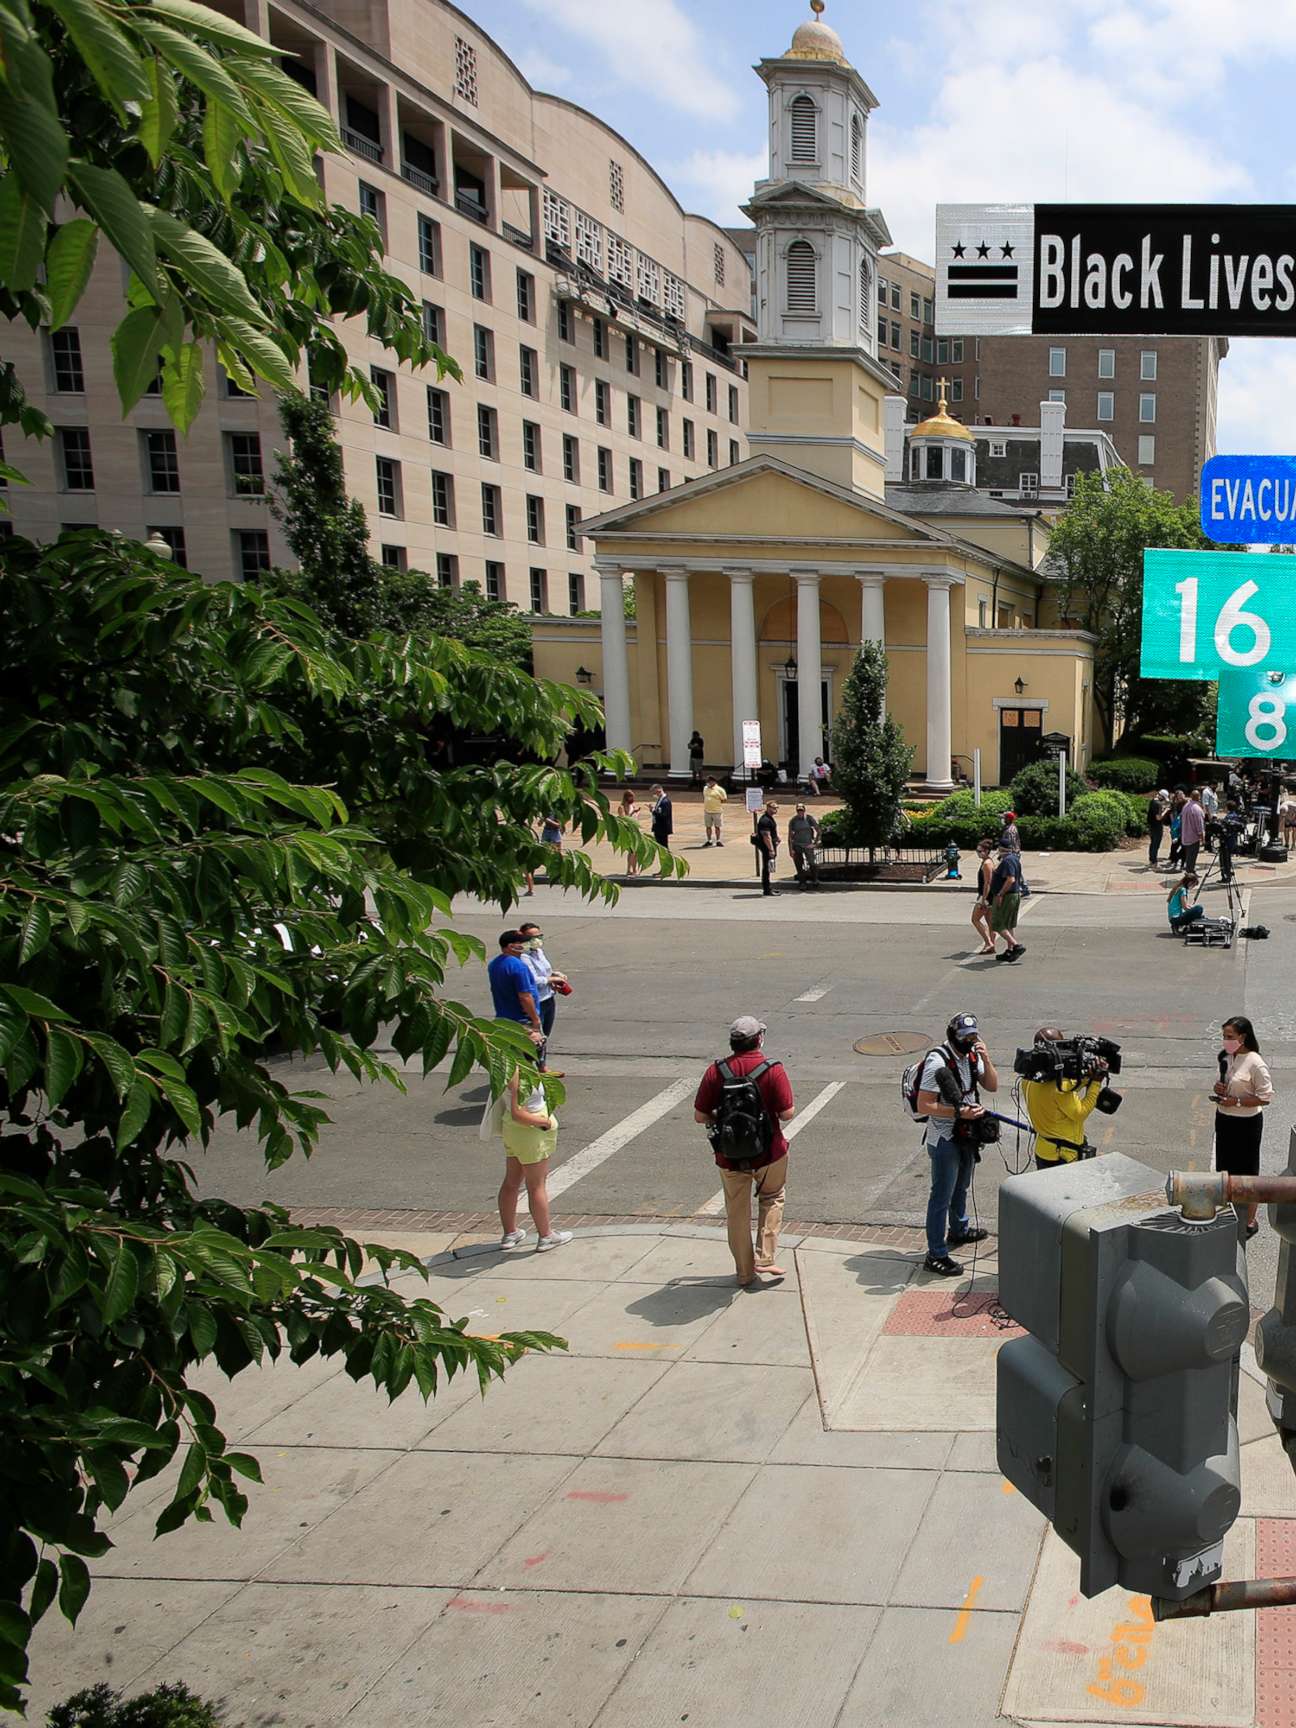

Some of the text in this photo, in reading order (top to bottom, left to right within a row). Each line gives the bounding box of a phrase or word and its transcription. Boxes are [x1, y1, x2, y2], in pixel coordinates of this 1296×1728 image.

[1039, 234, 1164, 310] Black
[1181, 233, 1295, 311] Lives
[1175, 577, 1270, 667] 16
